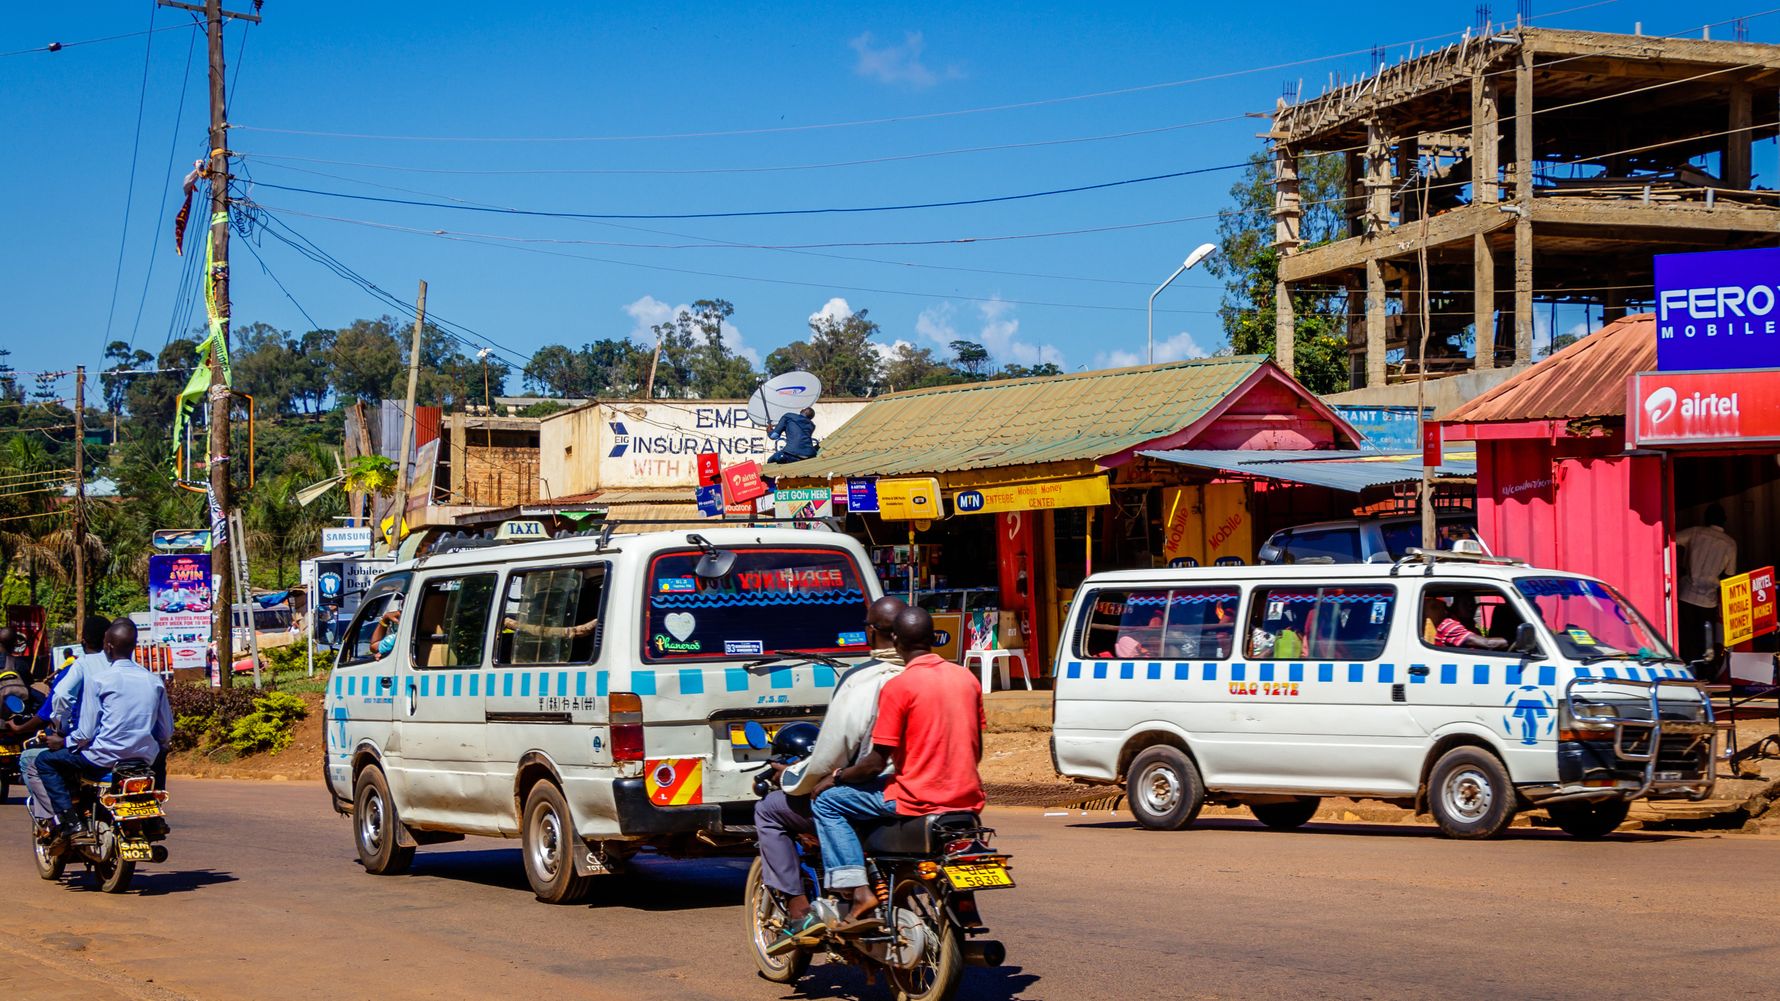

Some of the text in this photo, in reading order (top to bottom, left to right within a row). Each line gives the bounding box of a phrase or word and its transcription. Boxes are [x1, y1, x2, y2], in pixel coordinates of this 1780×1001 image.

[1660, 284, 1780, 321] FERO
[1661, 321, 1776, 339] MOBILE
[1680, 391, 1740, 417] airtel
[1382, 411, 1392, 422] &
[614, 436, 629, 444] EIG
[633, 437, 764, 455] INSURANCE
[633, 459, 680, 478] WITH
[741, 472, 758, 481] airtel
[743, 480, 757, 488] money
[1041, 483, 1063, 493] Money
[776, 491, 790, 501] GET
[790, 490, 809, 500] GOtv
[810, 489, 828, 500] HERE
[960, 493, 1055, 508] MTN ENTEBBE CENTER
[508, 522, 540, 535] TAXI
[1166, 507, 1189, 553] Mobile
[1208, 513, 1242, 552] Mobile
[176, 570, 204, 580] WIN
[347, 566, 385, 576] Jubilee
[779, 569, 842, 581] HIACE
[346, 579, 371, 589] Dent
[1729, 582, 1748, 599] MTN
[1728, 599, 1749, 616] MOBILE
[1729, 614, 1750, 630] MONEY
[655, 634, 700, 651] Phaneros
[935, 631, 948, 645] TN
[120, 842, 149, 851] SAM
[145, 850, 152, 858] 1
[964, 875, 1002, 887] 583R
